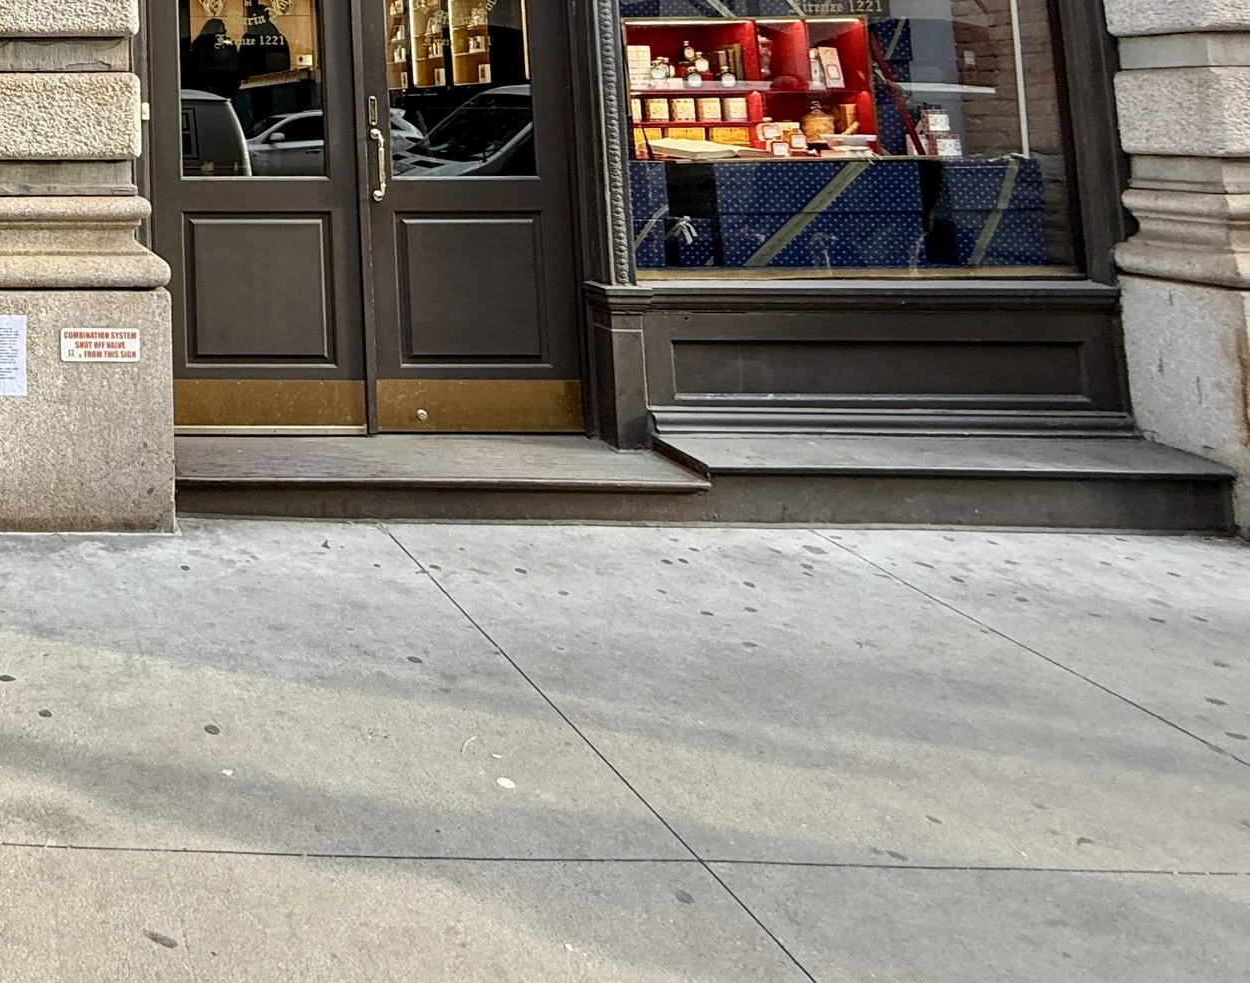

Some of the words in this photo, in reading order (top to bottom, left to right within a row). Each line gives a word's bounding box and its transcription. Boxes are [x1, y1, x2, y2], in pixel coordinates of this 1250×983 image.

[848, 0, 883, 13] 1221
[259, 35, 285, 46] 1221
[64, 331, 109, 339] COMBINATION
[110, 331, 137, 339] SYSTEM
[75, 341, 92, 349] SHUT
[94, 341, 105, 349] OFF
[106, 341, 126, 349] VALVE
[84, 350, 102, 358] FROM
[104, 350, 119, 358] THIS
[120, 350, 137, 358] SIGN
